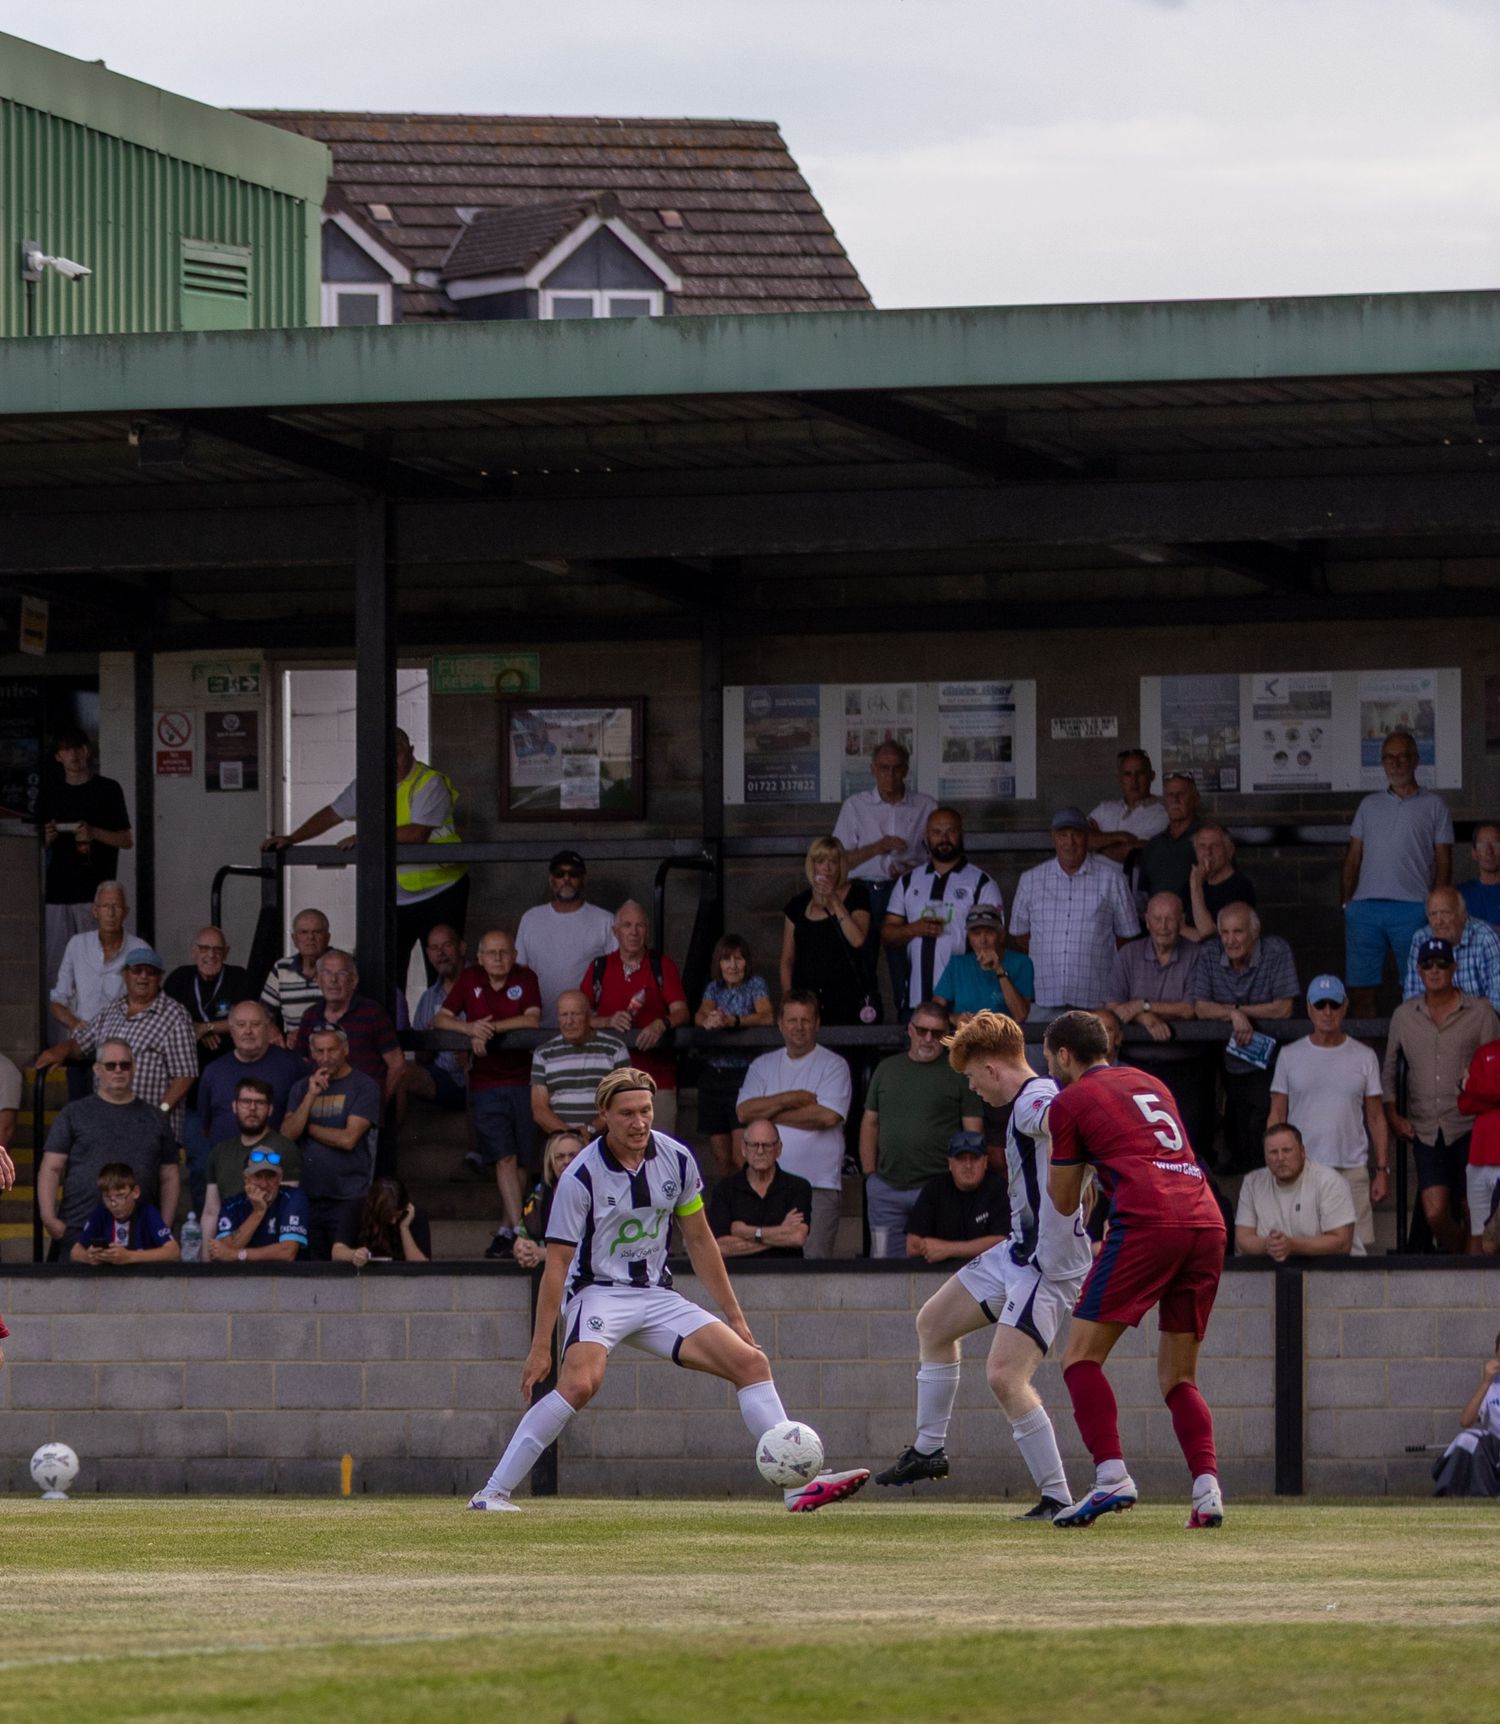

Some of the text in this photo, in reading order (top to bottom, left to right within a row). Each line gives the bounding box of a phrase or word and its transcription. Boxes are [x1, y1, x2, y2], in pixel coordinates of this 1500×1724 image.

[747, 779, 816, 792] 01722 337822
[1132, 1094, 1184, 1152] 5
